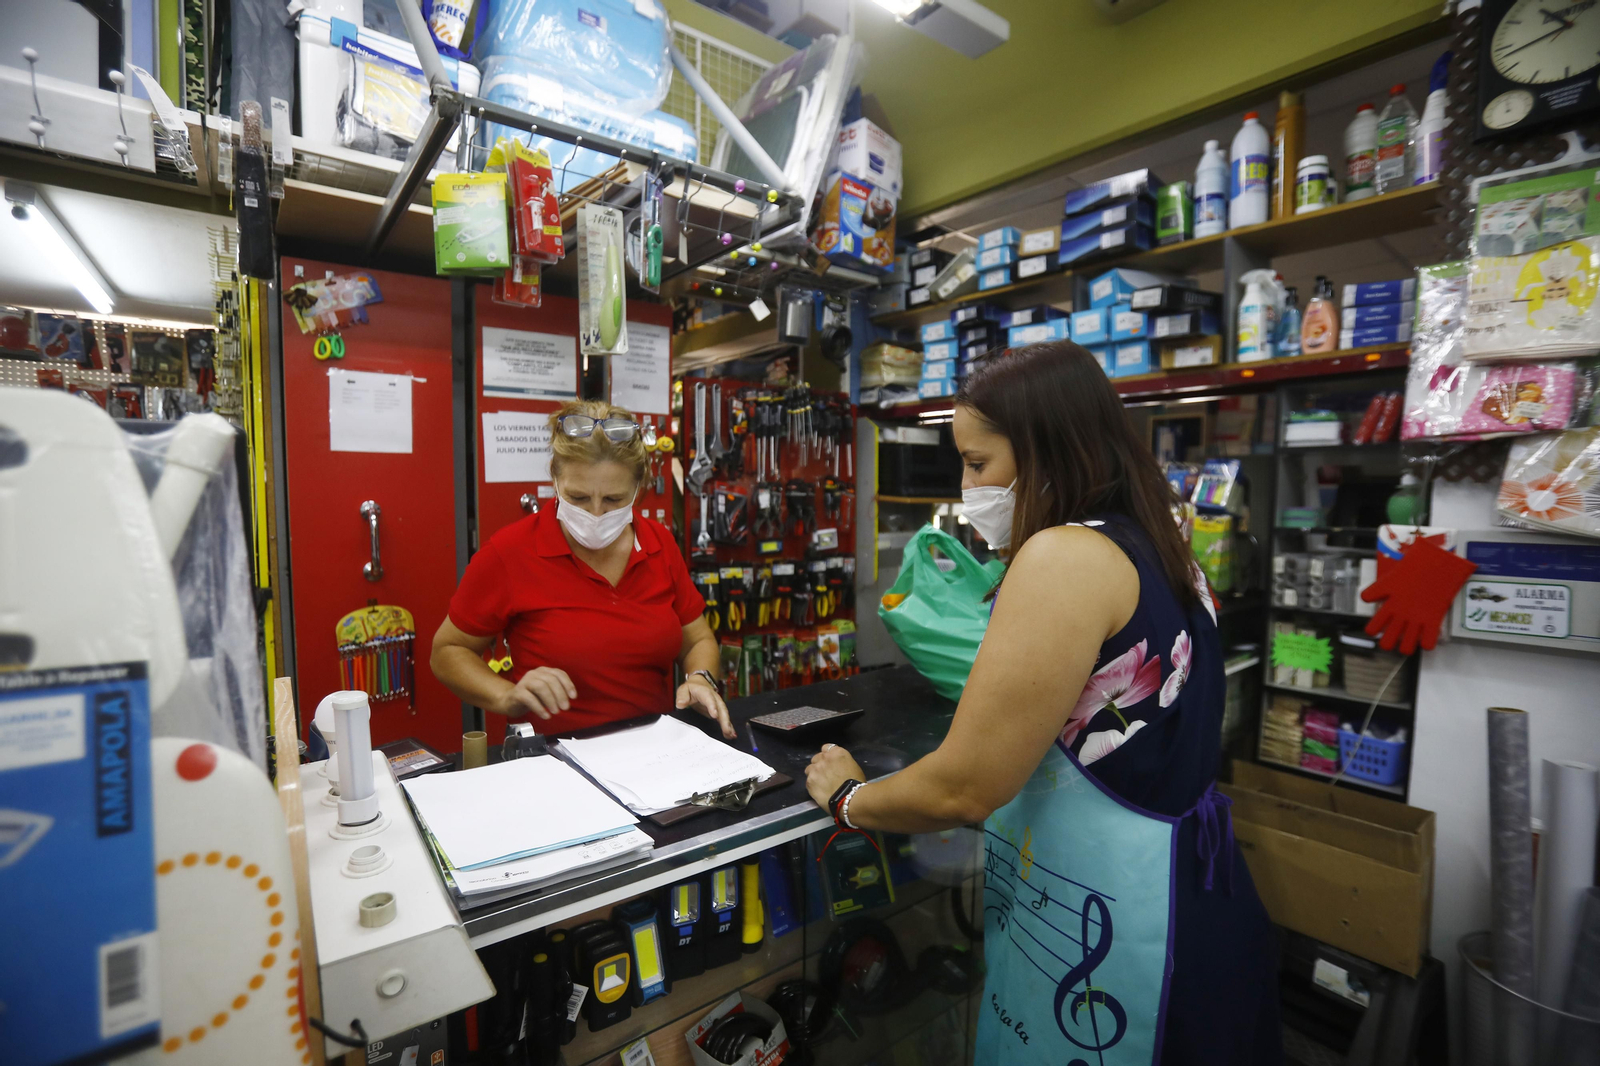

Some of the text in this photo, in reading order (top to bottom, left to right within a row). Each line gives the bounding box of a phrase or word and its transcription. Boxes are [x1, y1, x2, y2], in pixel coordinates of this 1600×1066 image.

[1515, 588, 1566, 600] ALARMA
[101, 697, 127, 827] AMAPOLA
[719, 923, 731, 933] DT
[679, 937, 691, 946] DT
[992, 993, 1029, 1045] la la la
[367, 1041, 384, 1054] LED
